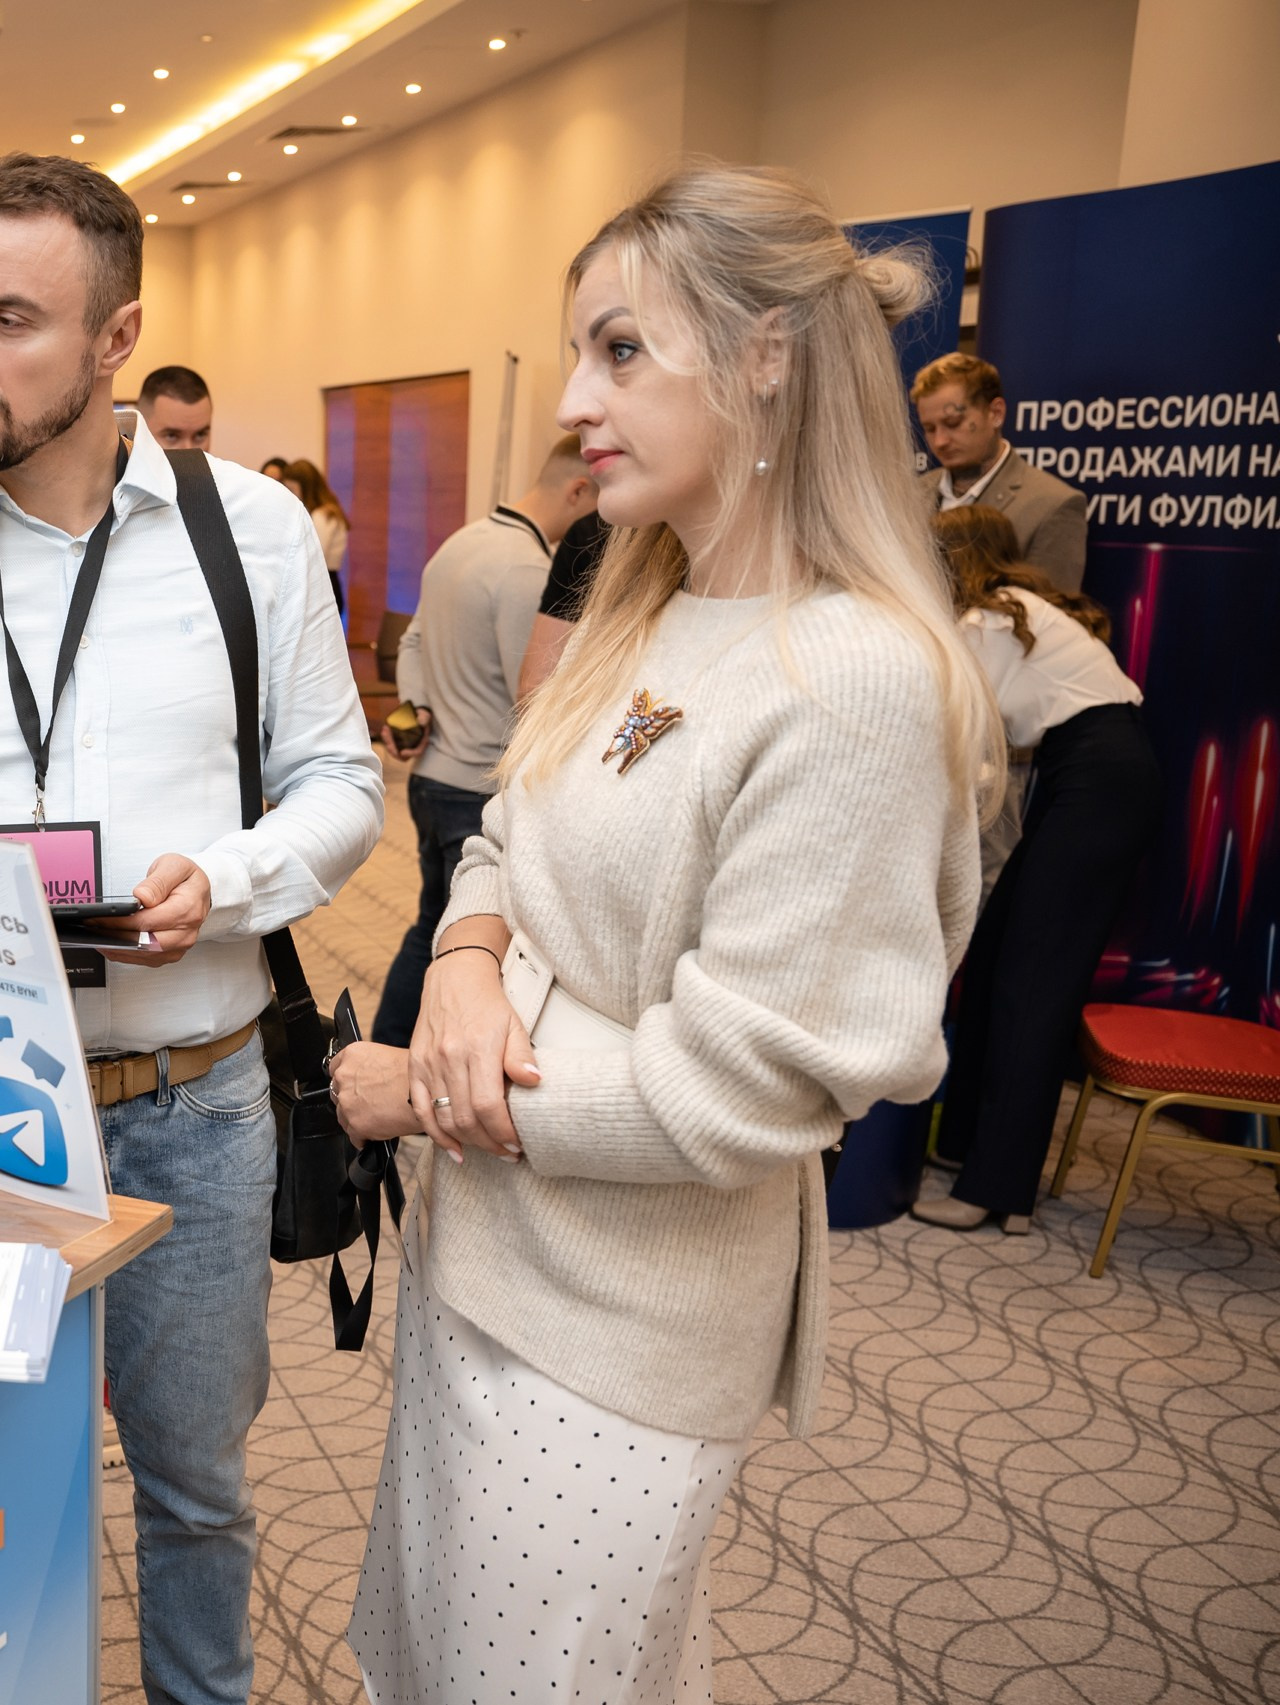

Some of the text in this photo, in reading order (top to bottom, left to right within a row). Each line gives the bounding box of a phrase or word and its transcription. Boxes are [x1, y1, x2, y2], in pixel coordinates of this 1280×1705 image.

[1015, 391, 1280, 432] ПРОФЕССИОНА
[1015, 444, 1241, 482] ПРОДАЖАМИ
[1148, 493, 1280, 530] ФУЛФИ
